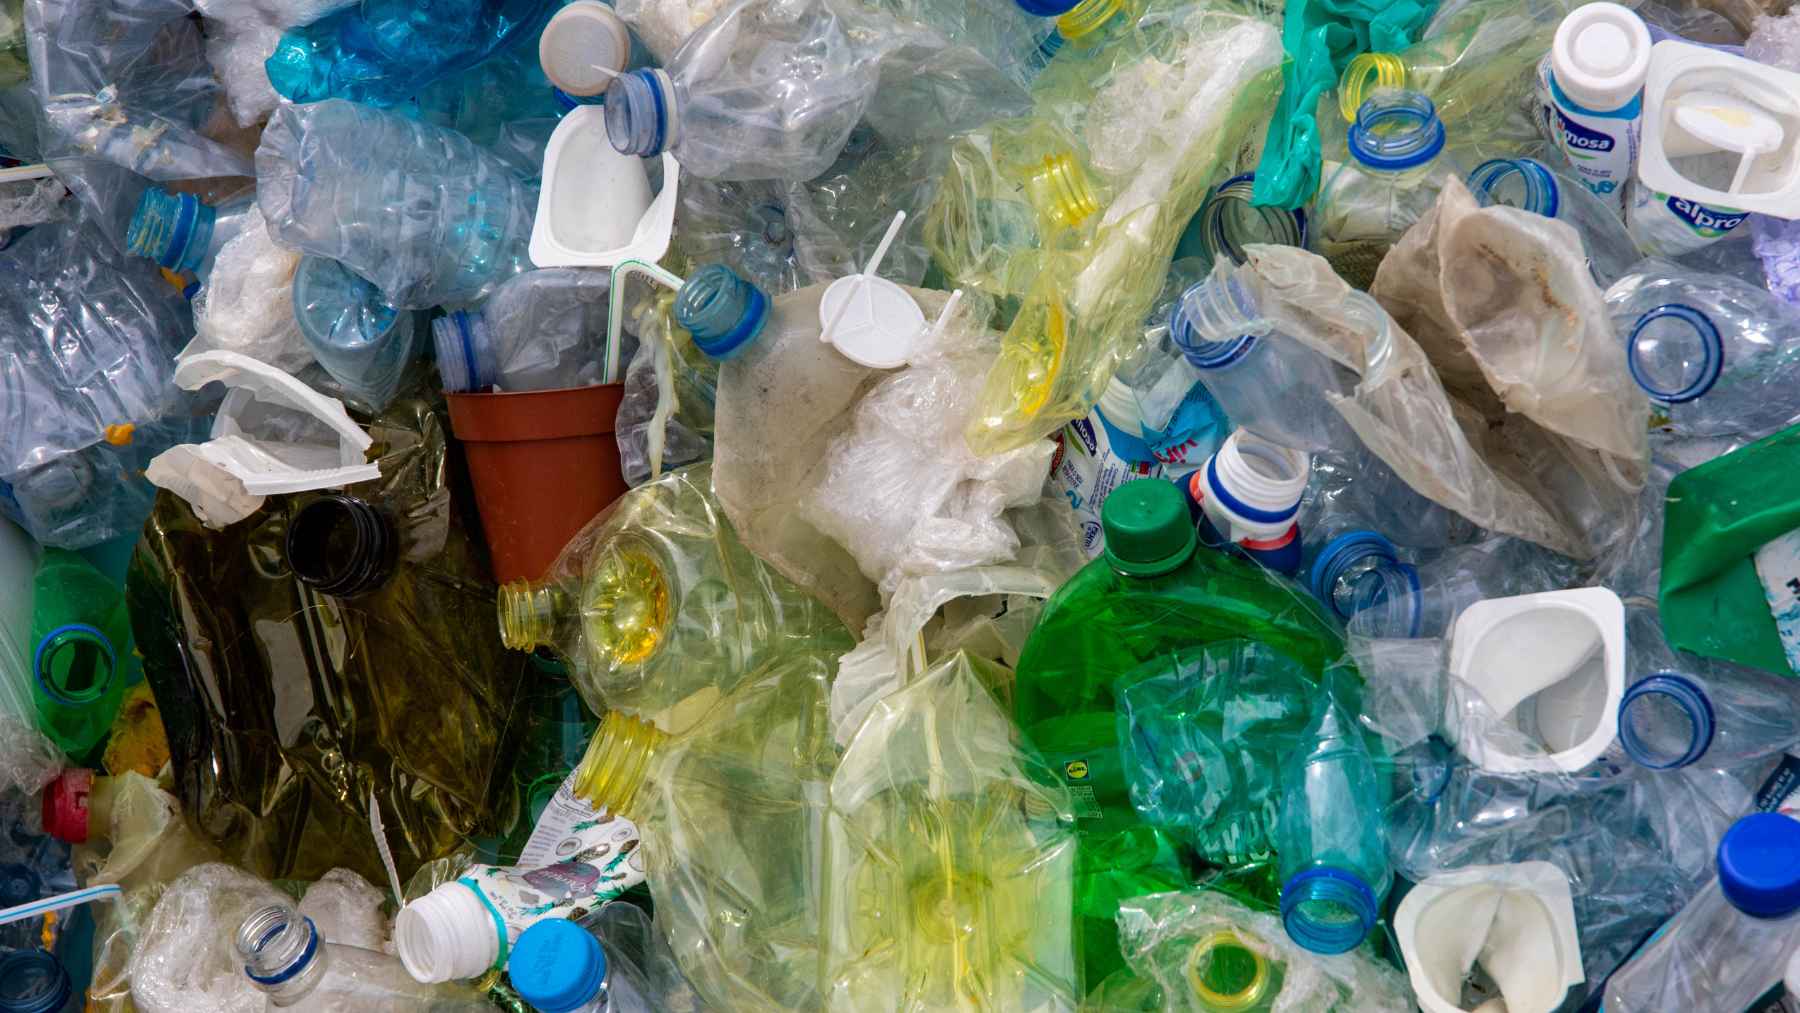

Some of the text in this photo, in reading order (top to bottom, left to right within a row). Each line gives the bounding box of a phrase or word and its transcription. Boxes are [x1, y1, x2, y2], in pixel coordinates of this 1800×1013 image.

[1564, 130, 1610, 149] mosa
[1674, 198, 1742, 229] alpro
[1075, 419, 1096, 450] mosa
